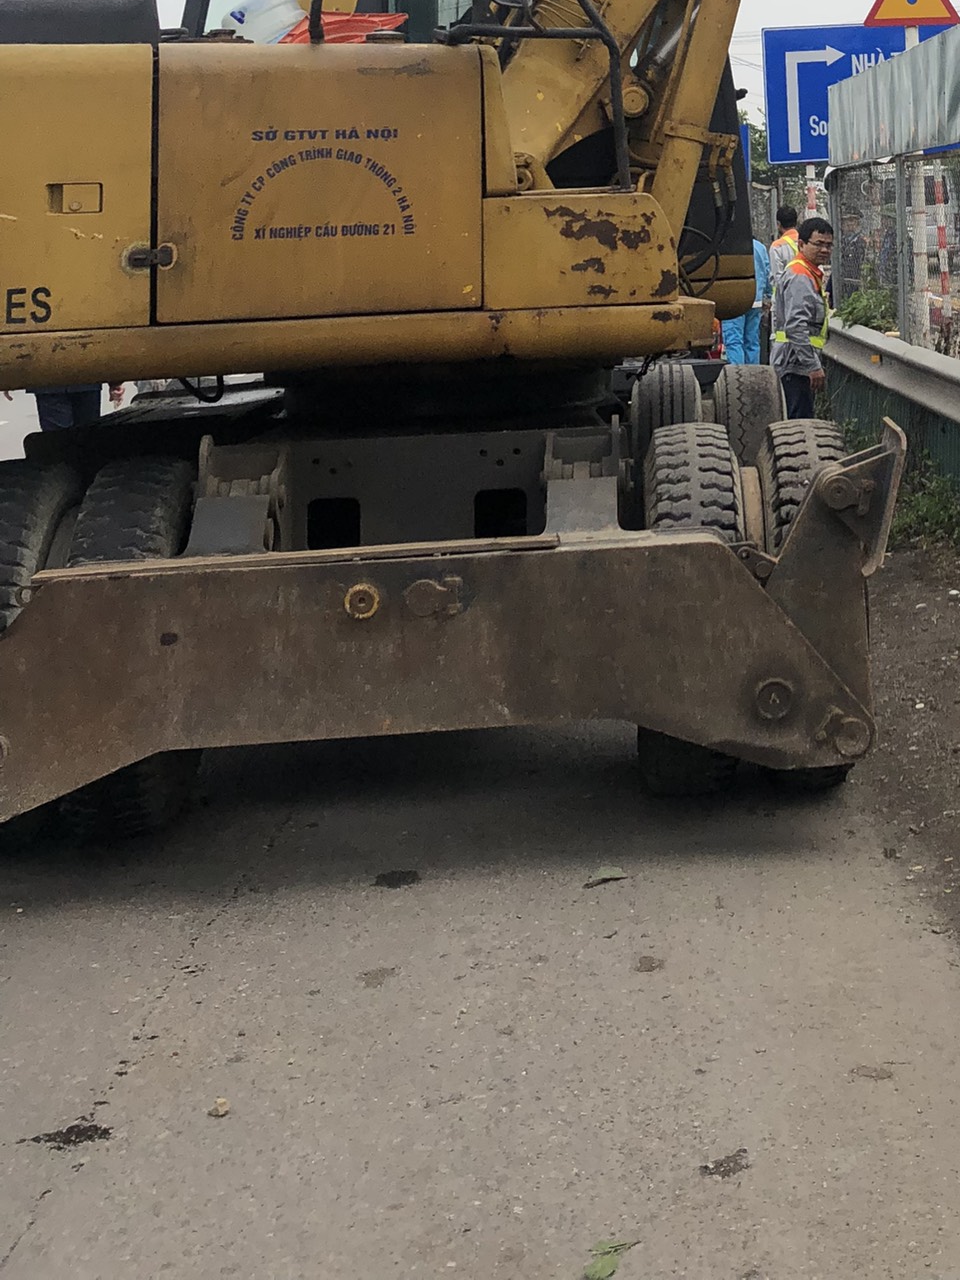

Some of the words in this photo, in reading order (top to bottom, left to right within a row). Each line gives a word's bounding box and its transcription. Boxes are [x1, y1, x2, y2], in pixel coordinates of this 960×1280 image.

[284, 129, 329, 141] GTVT
[240, 191, 256, 206] TY
[251, 176, 266, 192] CP
[336, 148, 363, 164] GIAO
[392, 187, 403, 197] 2
[383, 224, 396, 235] 21
[6, 286, 52, 324] ES
